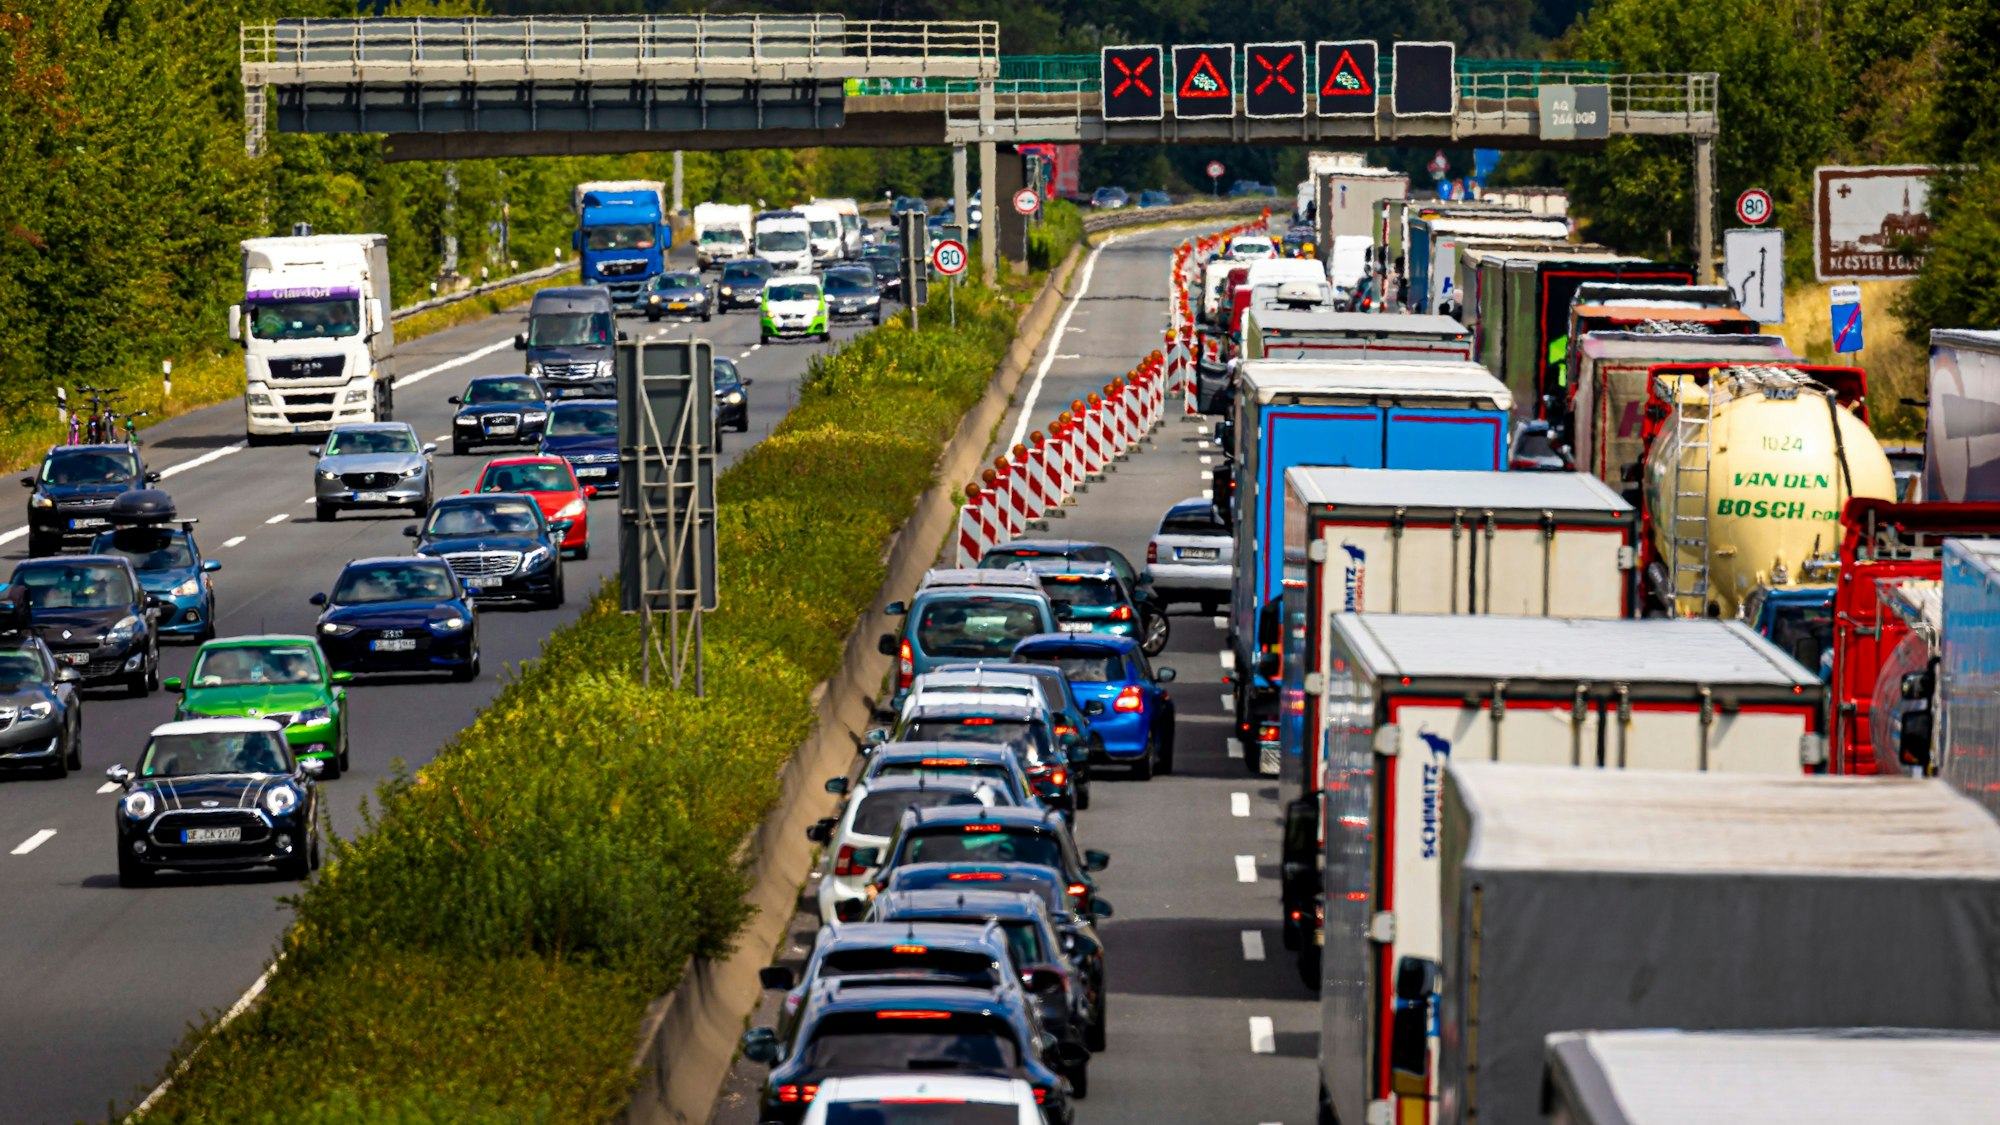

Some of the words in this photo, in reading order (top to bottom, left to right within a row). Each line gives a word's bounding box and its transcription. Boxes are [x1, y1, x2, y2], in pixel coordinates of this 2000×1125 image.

[1553, 101, 1569, 111] AQ
[1745, 199, 1764, 215] 80
[941, 250, 961, 266] 80
[1762, 436, 1804, 451] 1024
[1734, 472, 1779, 487] VAN
[1783, 473, 1830, 488] DEN
